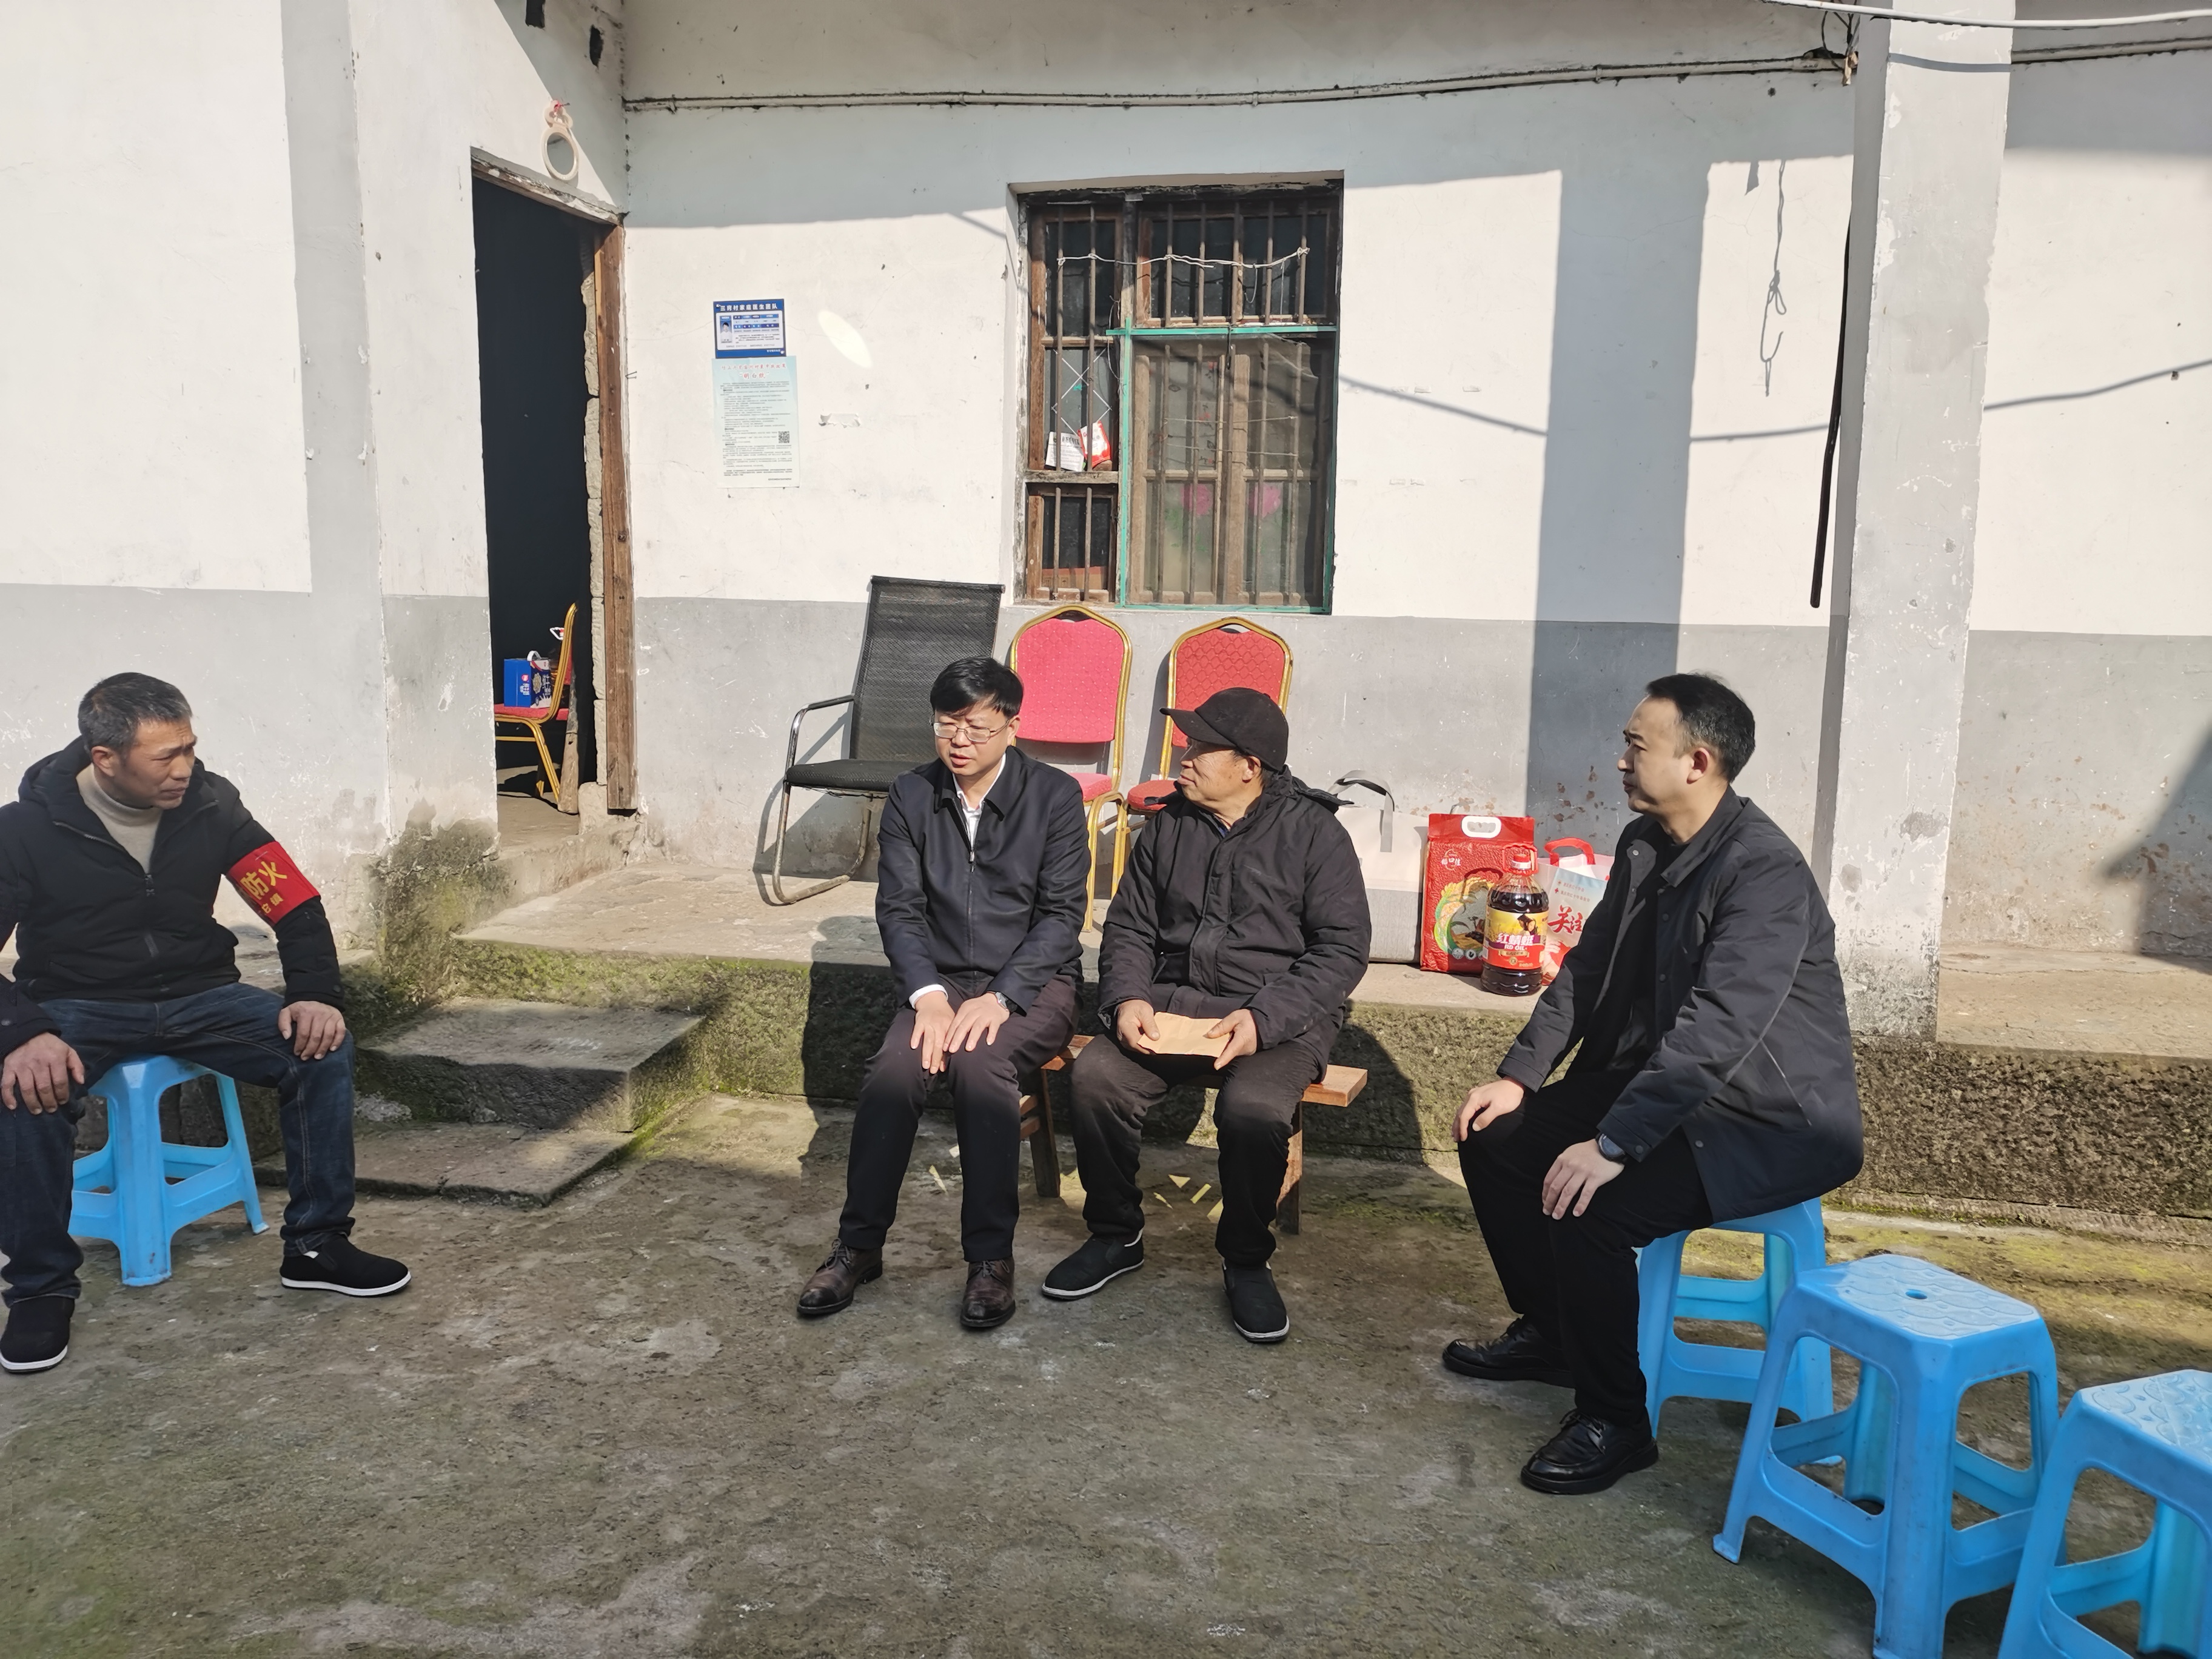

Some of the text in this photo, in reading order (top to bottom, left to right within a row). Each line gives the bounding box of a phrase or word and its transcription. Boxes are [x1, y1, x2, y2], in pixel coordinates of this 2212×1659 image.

[240, 861, 287, 900] 防火
[1547, 905, 1583, 933] 关注
[1496, 933, 1534, 946] 红蜻蜓
